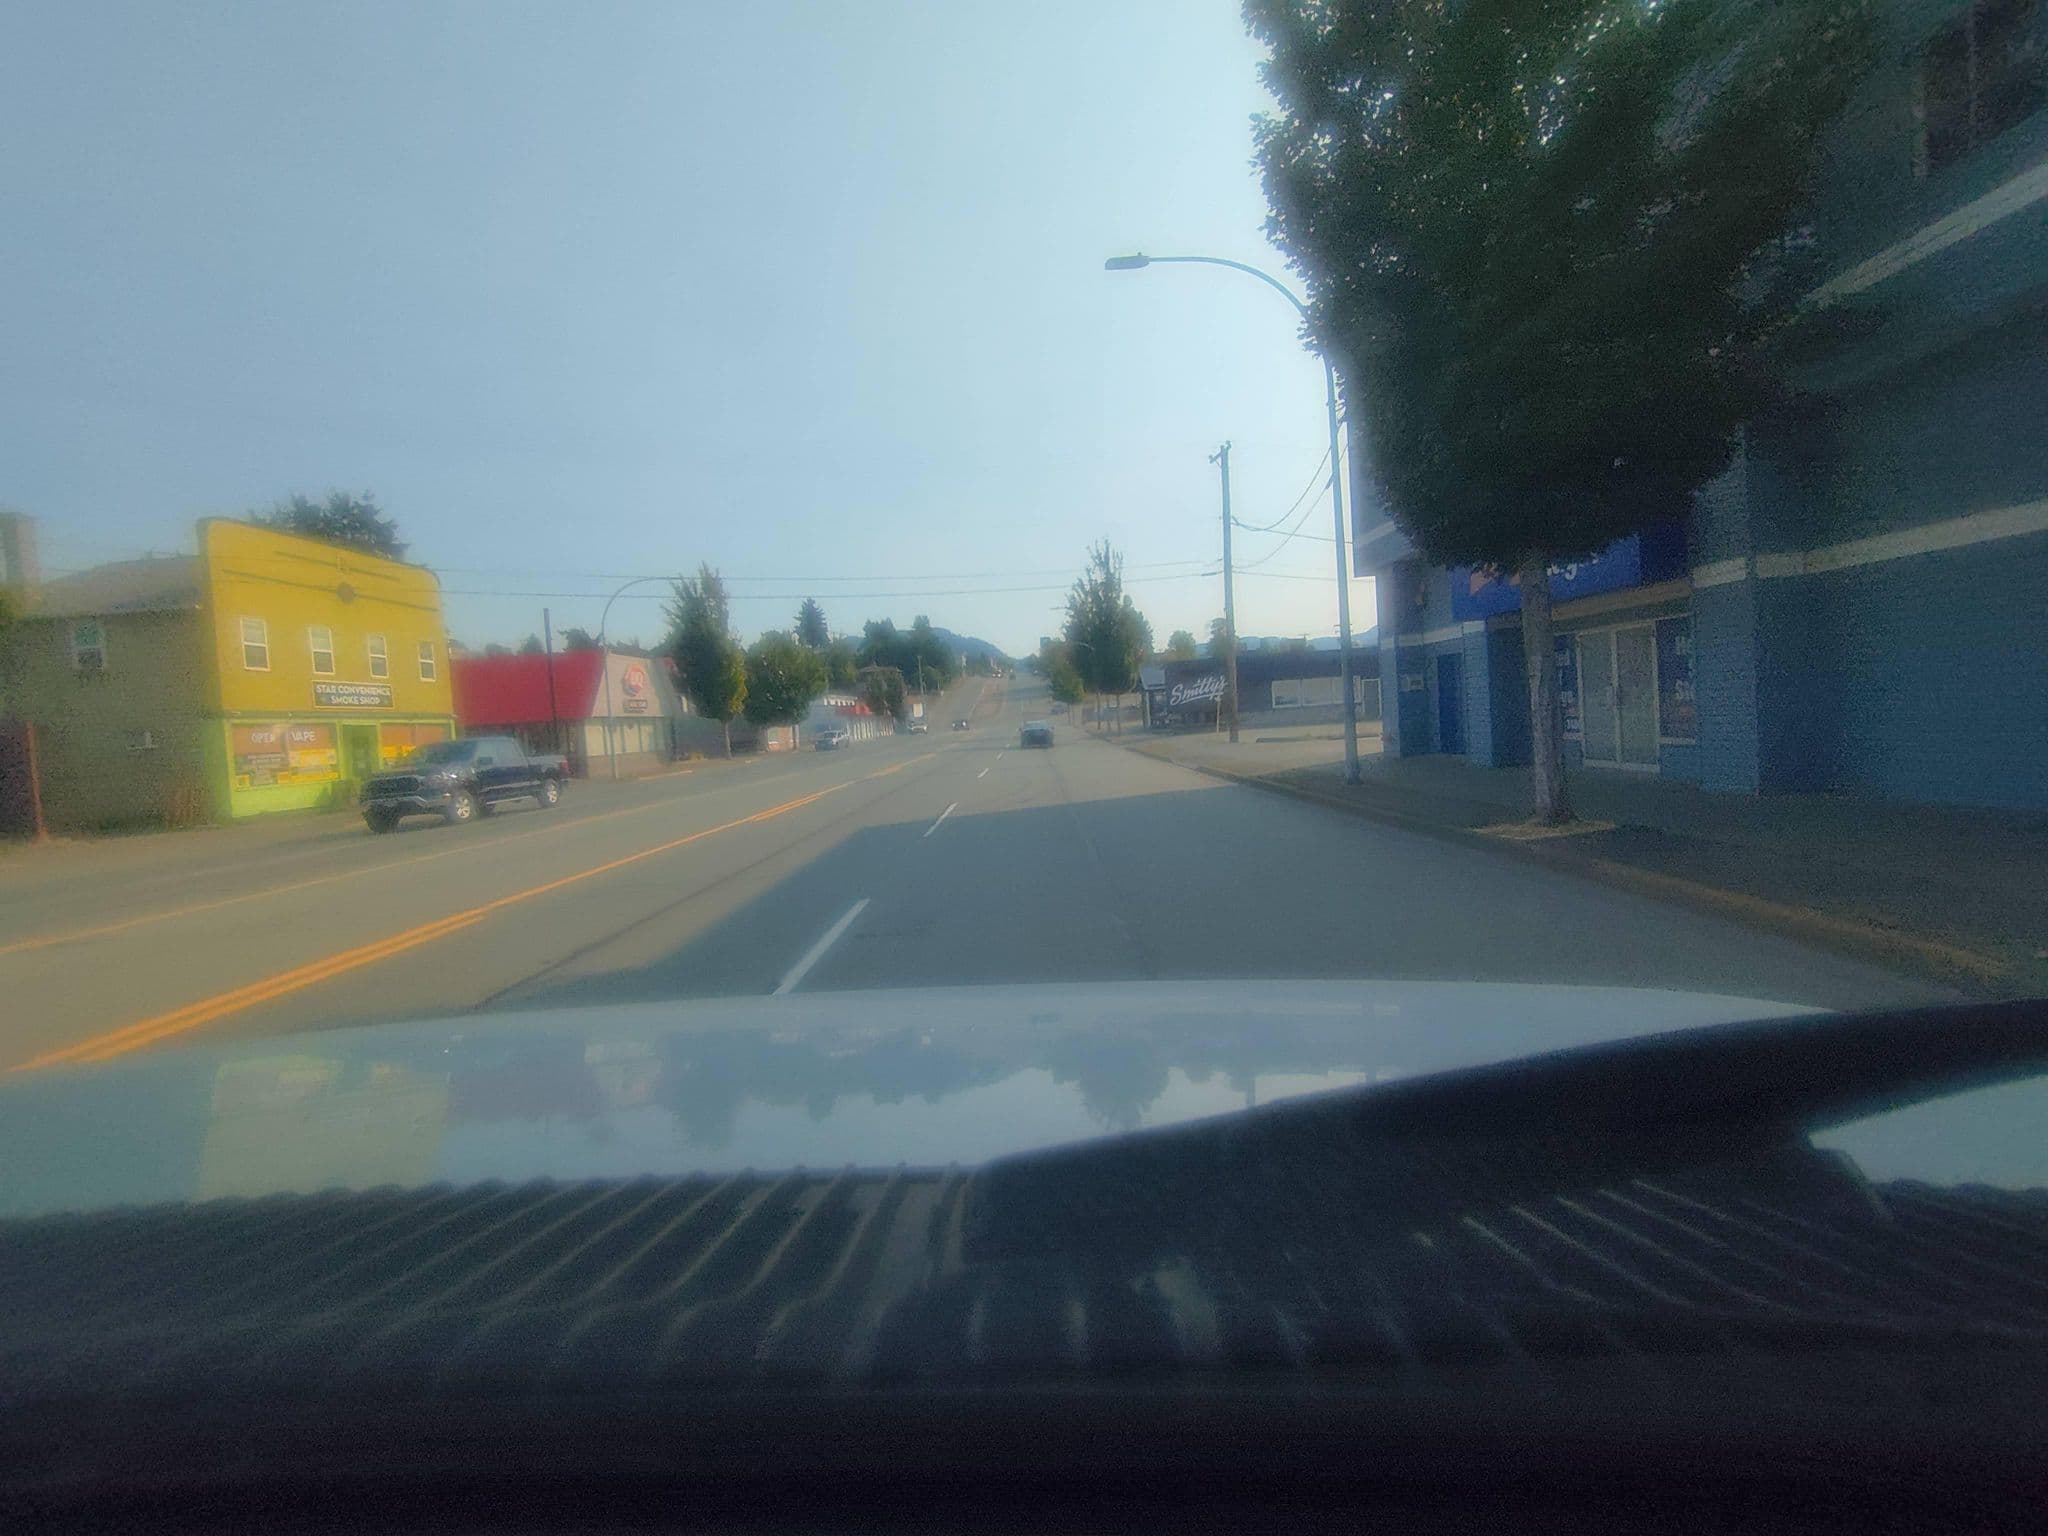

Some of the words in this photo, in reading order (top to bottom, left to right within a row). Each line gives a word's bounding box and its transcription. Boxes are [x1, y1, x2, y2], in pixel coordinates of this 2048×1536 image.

[316, 685, 336, 694] STAR
[338, 686, 390, 696] CONVENIENCE
[1170, 675, 1228, 706] Smitty's
[331, 696, 358, 705] SMOKE
[360, 697, 380, 705] SHOP
[251, 733, 275, 743] OPEN
[291, 731, 316, 742] VAPE
